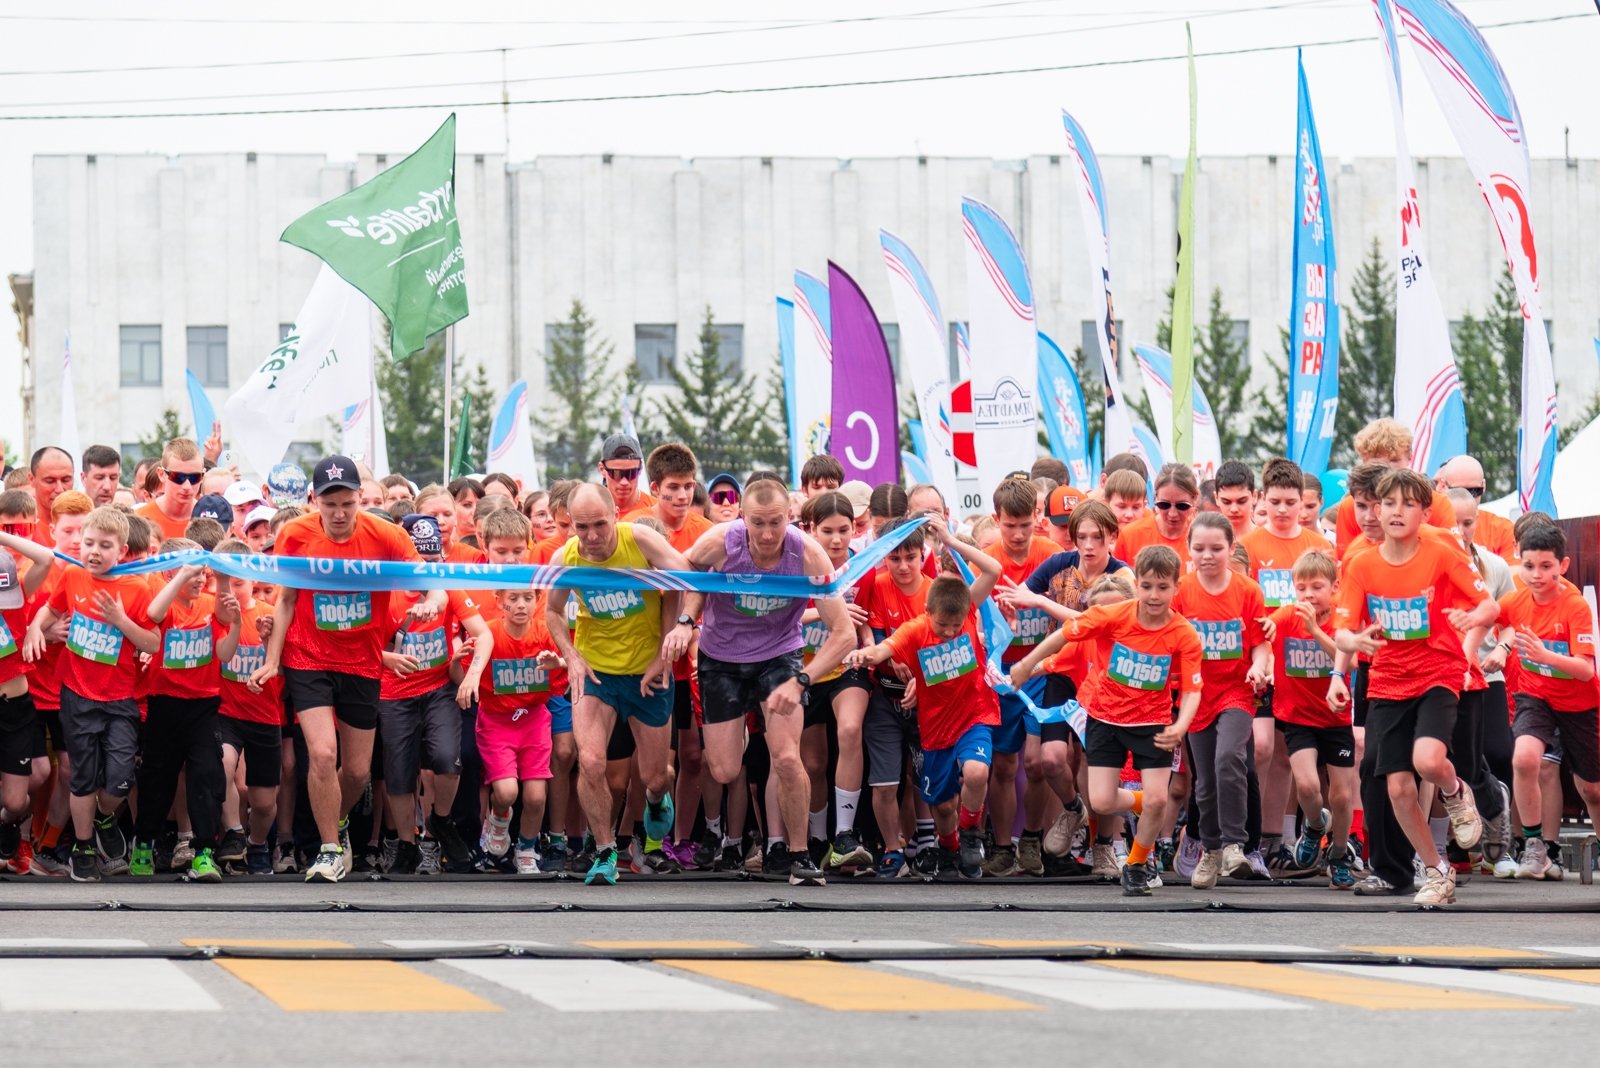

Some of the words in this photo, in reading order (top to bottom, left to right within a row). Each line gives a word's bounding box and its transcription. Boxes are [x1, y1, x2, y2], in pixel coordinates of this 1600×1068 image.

[1304, 302, 1325, 337] ЗА
[240, 554, 279, 573] KM
[306, 557, 334, 574] 10
[343, 558, 381, 575] KM
[1264, 580, 1297, 598] 1034
[588, 589, 638, 613] 10064
[319, 602, 367, 622] 10045
[611, 610, 626, 619] 1KM
[1373, 608, 1422, 631] 10169
[337, 622, 352, 631] 1KM
[1014, 616, 1049, 638] 0306
[1390, 631, 1406, 640] 1KM
[73, 625, 118, 656] 10252
[169, 636, 210, 659] 10406
[1199, 630, 1237, 651] 0420
[82, 649, 97, 661] 1KM
[185, 659, 197, 668] 1KM
[925, 645, 972, 677] 10266
[1207, 651, 1221, 660] 1KM
[417, 661, 431, 671] 1KM
[946, 669, 960, 681] 1KM
[1116, 656, 1162, 683] 10156
[1306, 669, 1320, 678] 1KM
[515, 686, 529, 694] 1KM
[1128, 679, 1143, 689] 1KM
